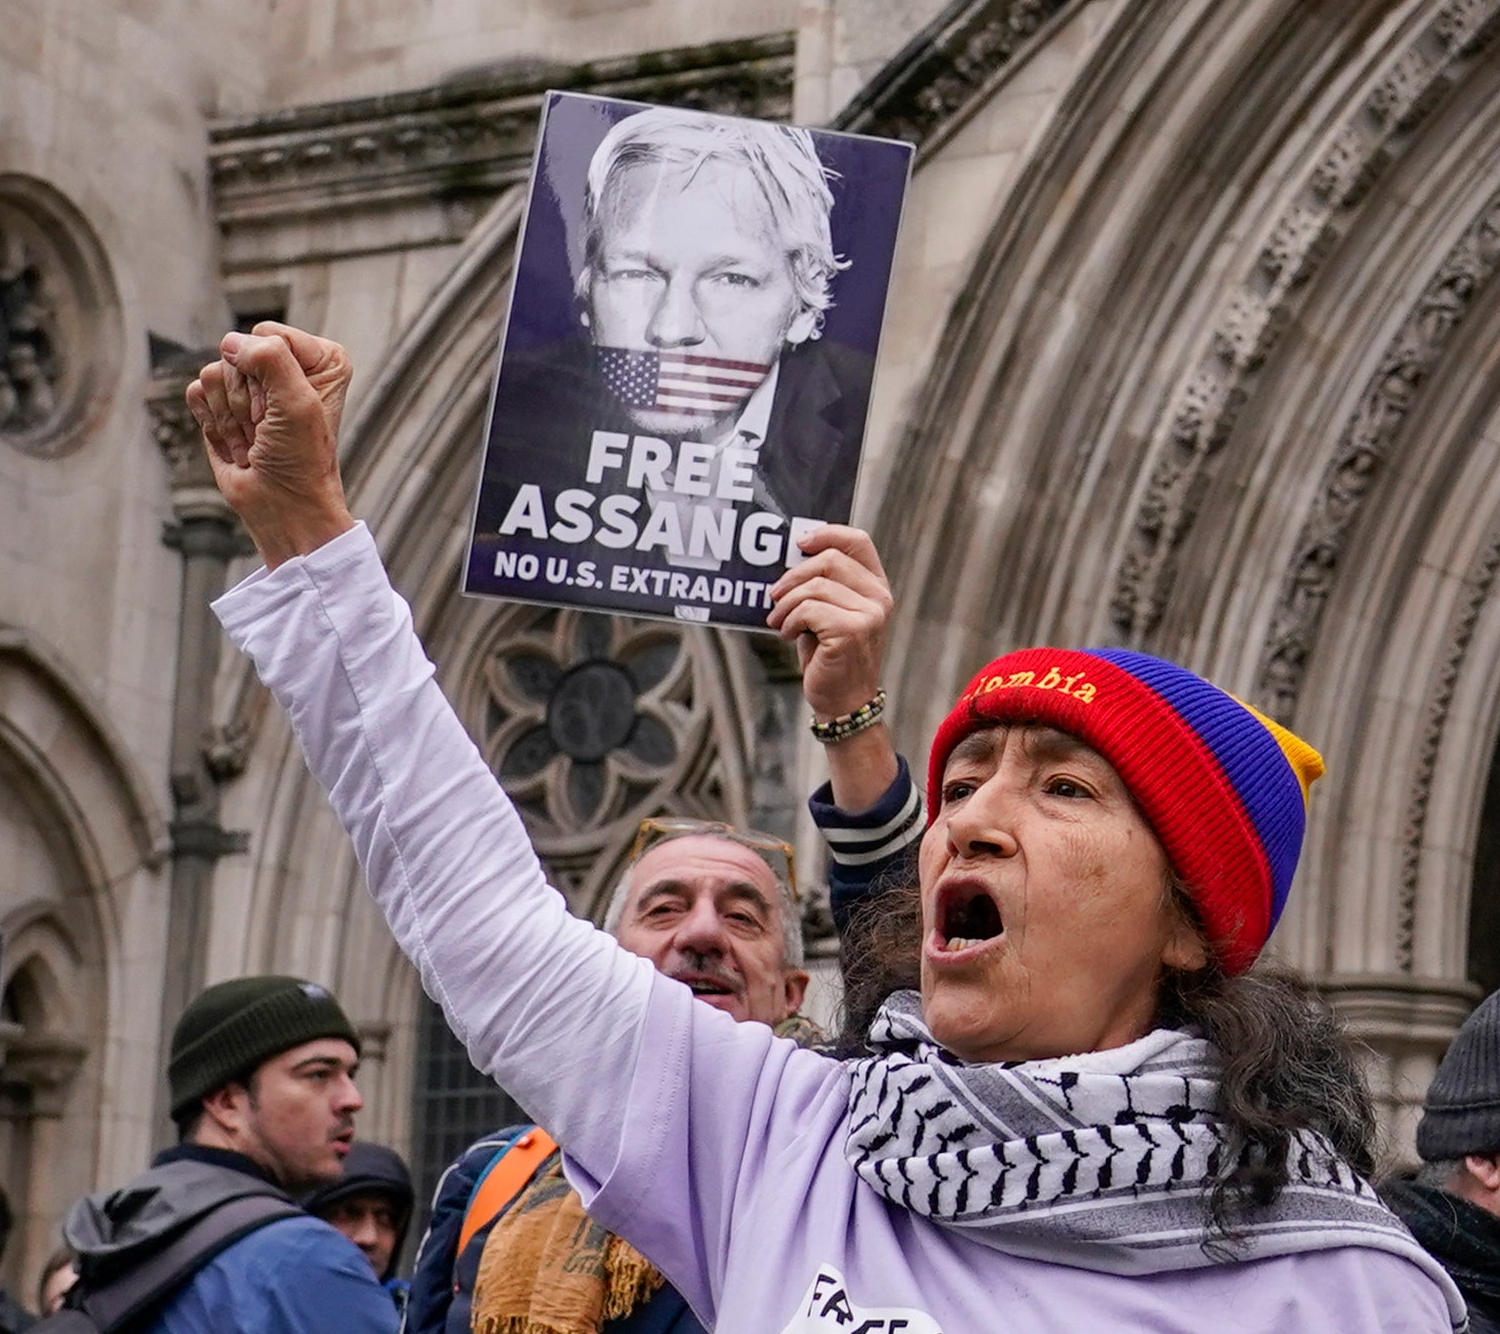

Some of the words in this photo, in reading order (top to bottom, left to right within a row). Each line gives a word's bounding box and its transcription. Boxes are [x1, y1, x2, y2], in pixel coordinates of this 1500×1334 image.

[585, 429, 759, 503] FREE
[494, 550, 539, 582] NO
[546, 555, 604, 589] U.S.
